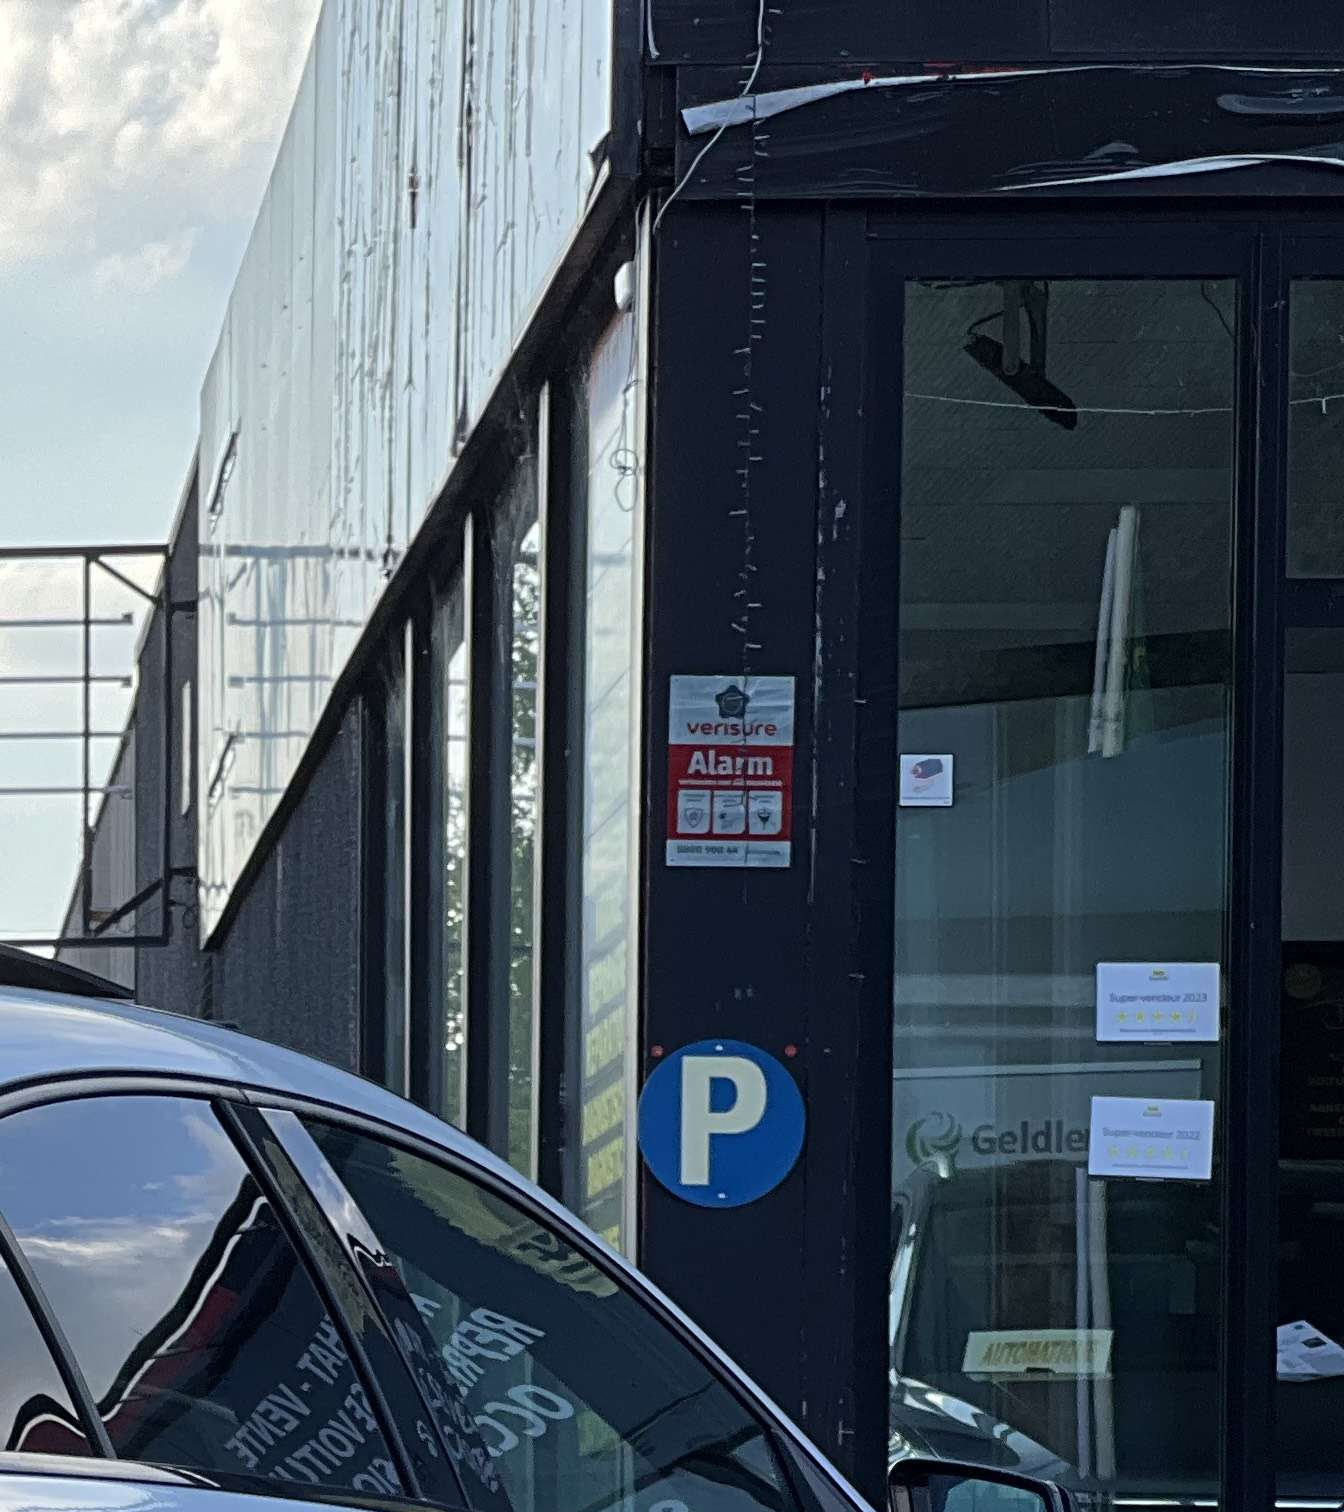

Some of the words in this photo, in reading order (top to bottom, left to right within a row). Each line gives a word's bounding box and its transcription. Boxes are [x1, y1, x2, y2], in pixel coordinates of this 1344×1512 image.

[687, 721, 777, 737] verisure
[688, 750, 773, 775] Alarm
[681, 1055, 767, 1186] P
